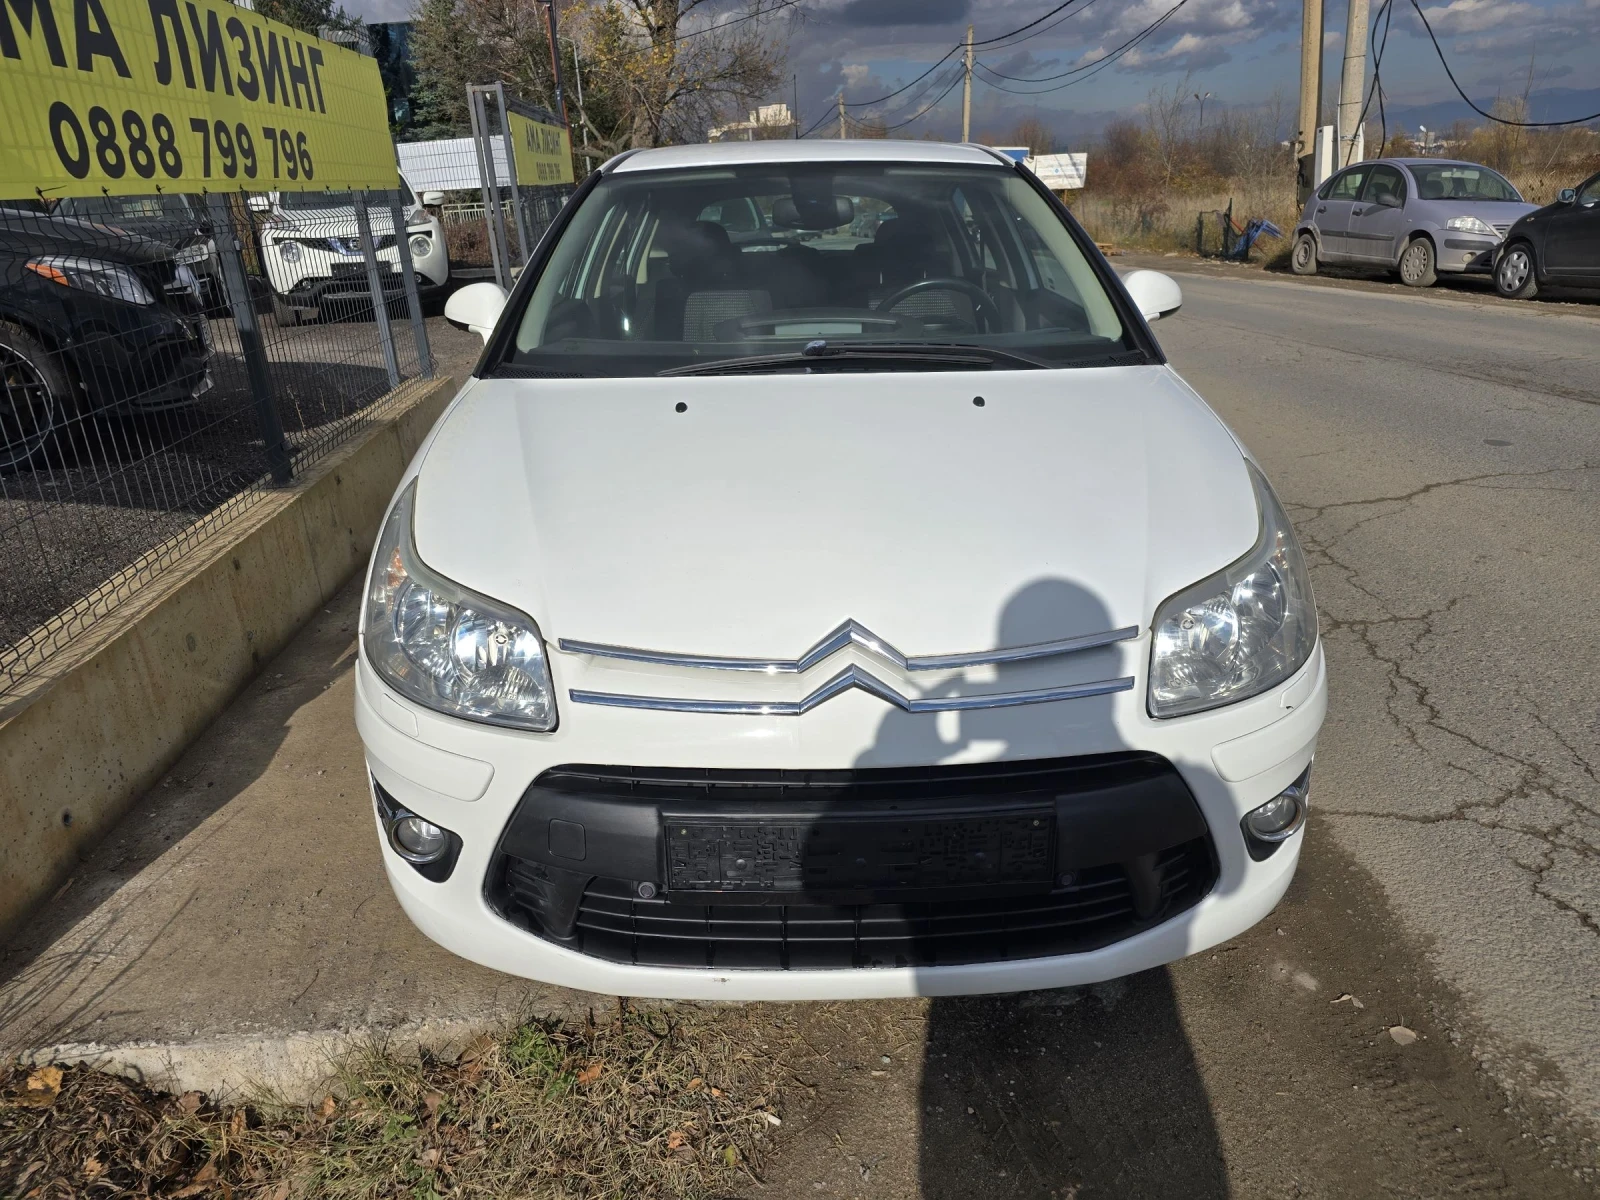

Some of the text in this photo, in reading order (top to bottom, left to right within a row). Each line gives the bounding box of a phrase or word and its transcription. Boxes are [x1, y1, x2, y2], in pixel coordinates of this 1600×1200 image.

[149, 0, 327, 114] ЛИЗИНГ
[49, 101, 314, 181] 0888 799 796
